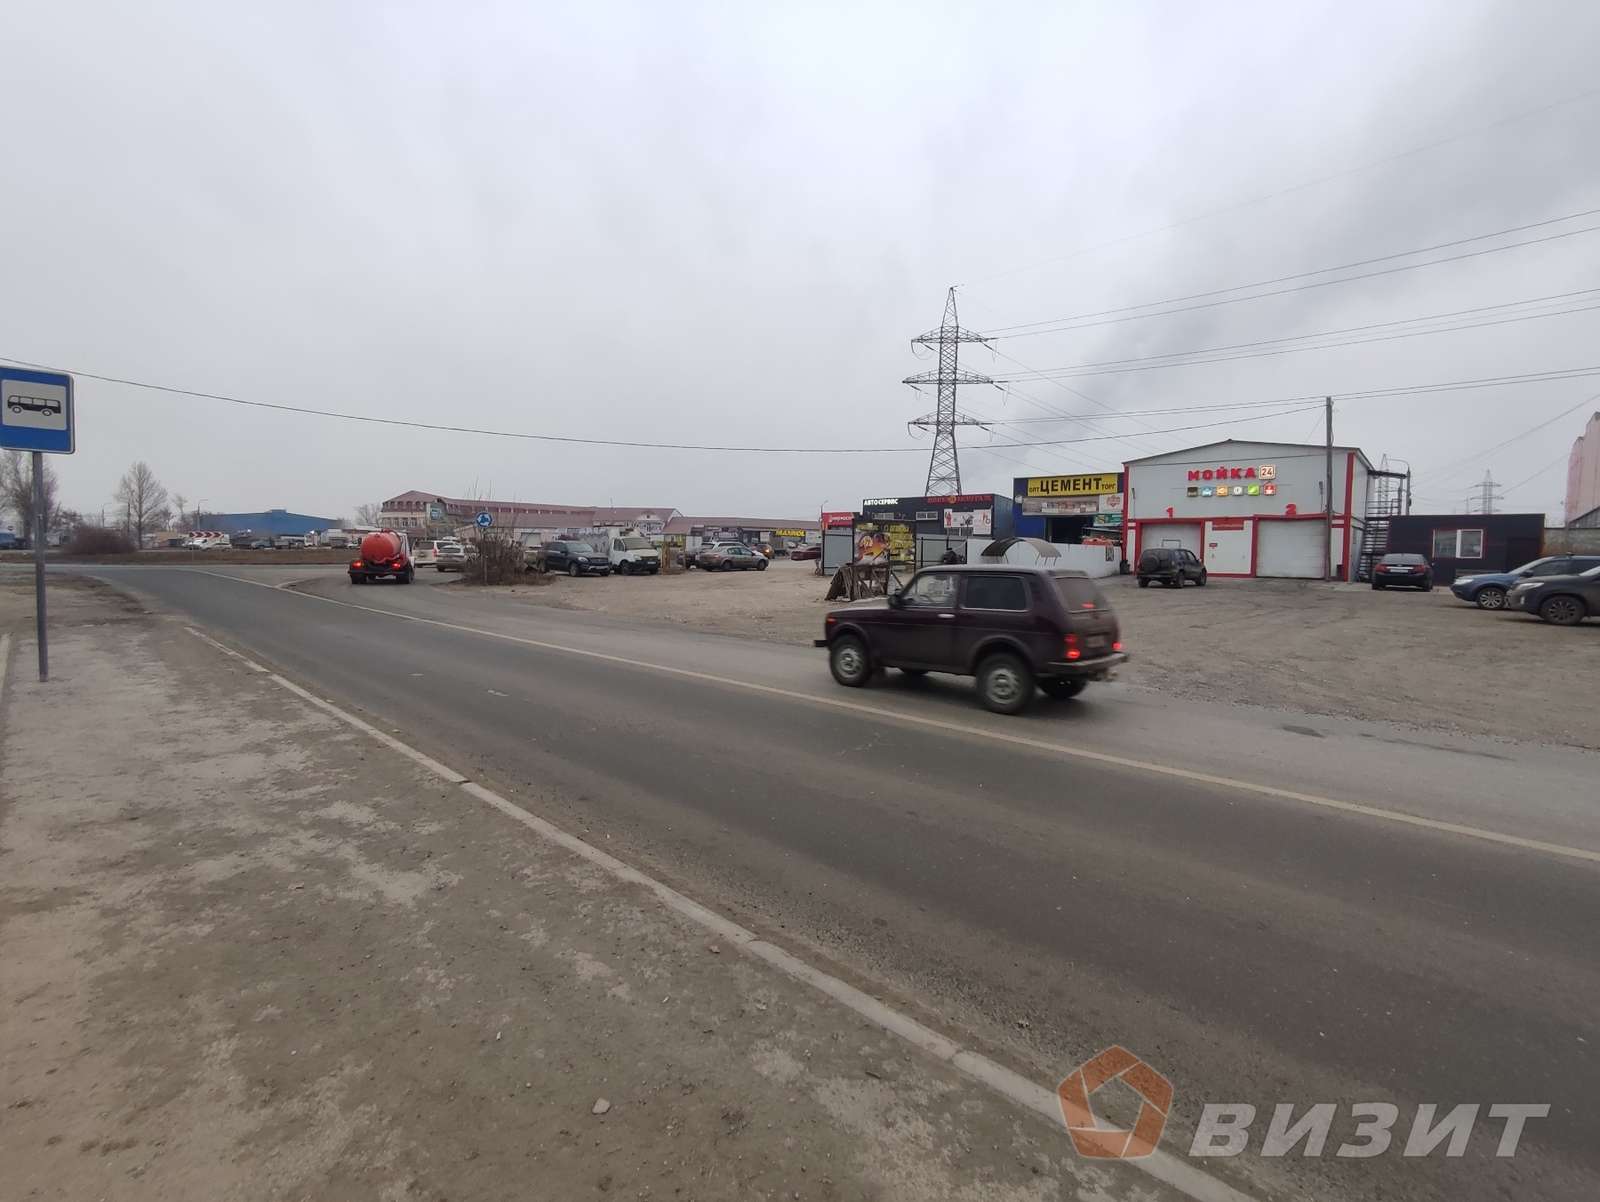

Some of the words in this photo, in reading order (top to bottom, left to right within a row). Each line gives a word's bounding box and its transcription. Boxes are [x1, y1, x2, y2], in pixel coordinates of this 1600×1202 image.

[1187, 466, 1257, 481] МОЙКА
[1261, 467, 1273, 477] 24
[1040, 477, 1102, 494] ЦЕМЕНТ
[1165, 507, 1174, 518] 1
[1285, 503, 1297, 516] 2
